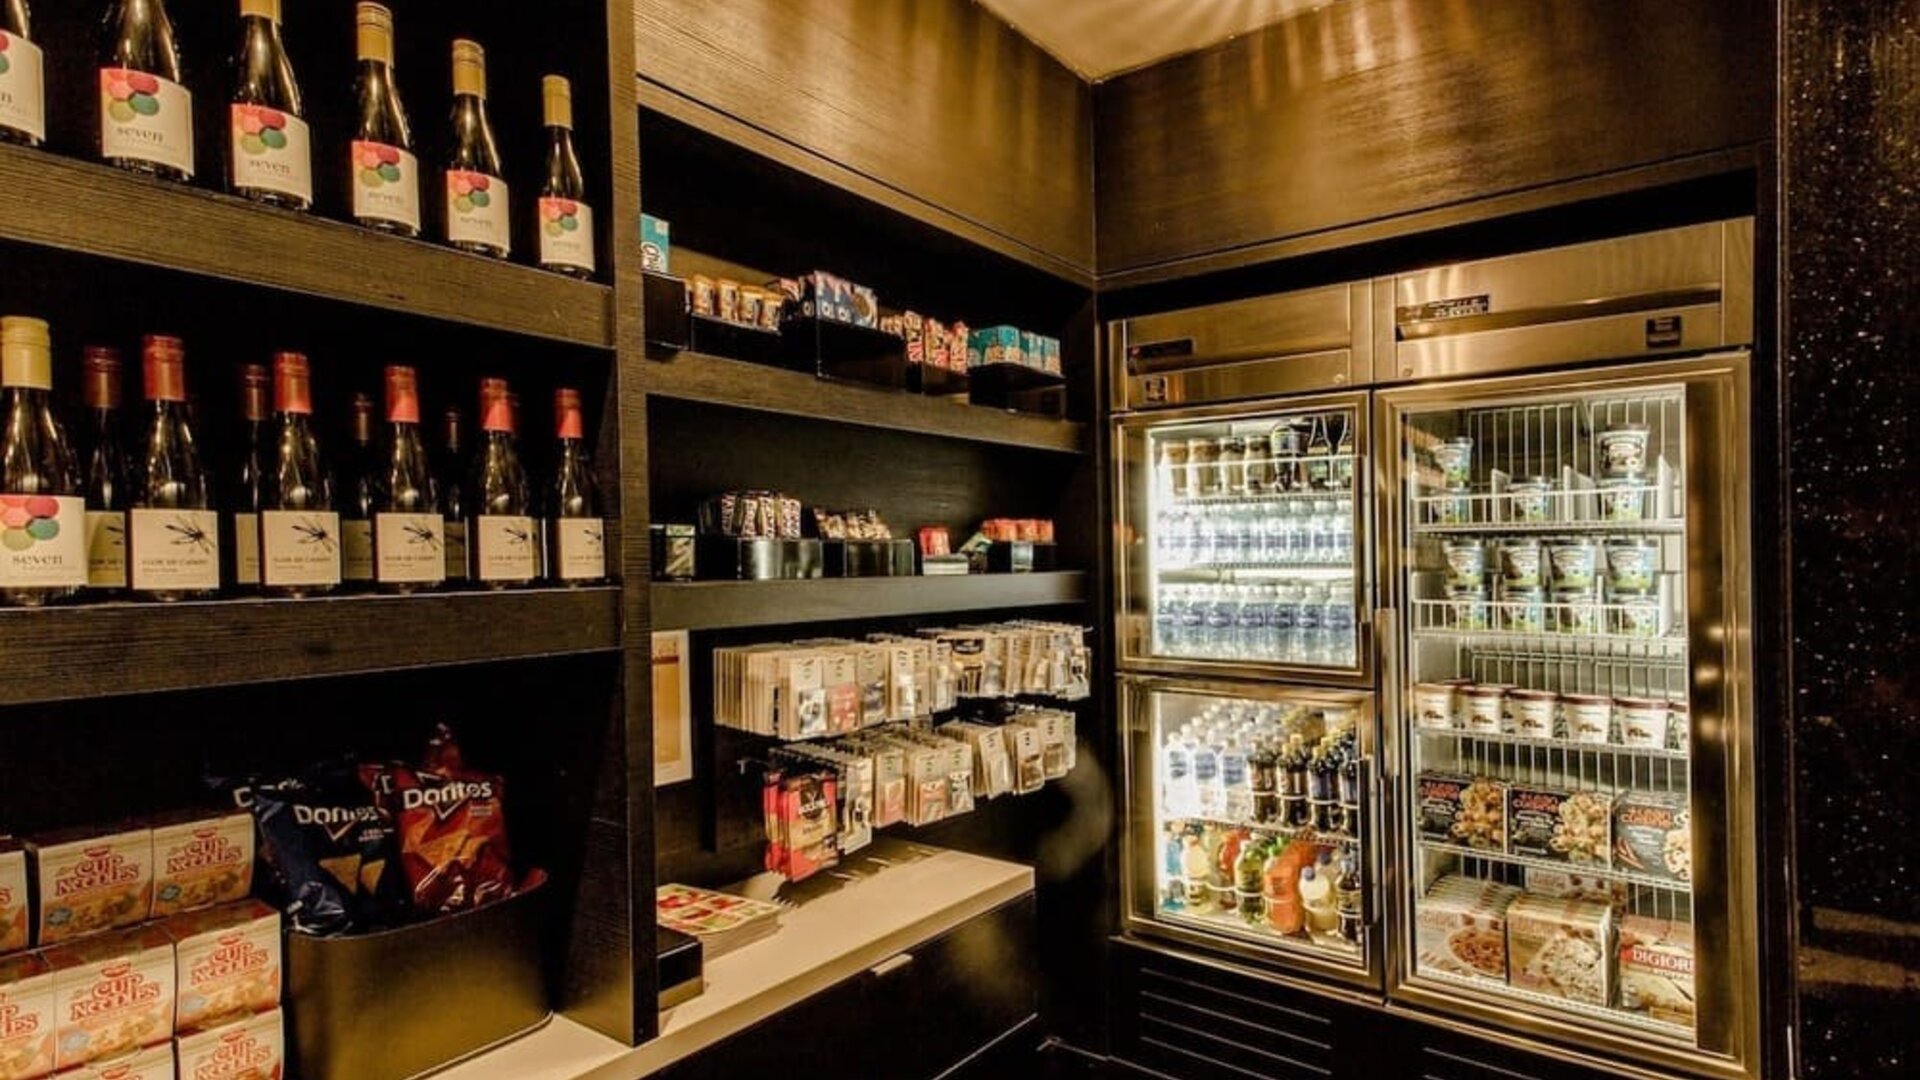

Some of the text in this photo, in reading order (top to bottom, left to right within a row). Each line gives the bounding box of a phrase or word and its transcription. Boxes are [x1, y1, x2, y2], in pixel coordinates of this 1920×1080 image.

[117, 126, 163, 143] seven
[250, 160, 291, 174] seven
[12, 554, 64, 566] seven
[403, 781, 493, 810] Doritos
[185, 836, 229, 858] CUP
[76, 853, 124, 878] CUP
[166, 847, 242, 874] NOODLES
[56, 863, 140, 897] NOODLES
[210, 942, 254, 966] CUP
[191, 950, 268, 985] NOODLES
[92, 974, 143, 999] CUP
[70, 982, 160, 1021] NOODLES
